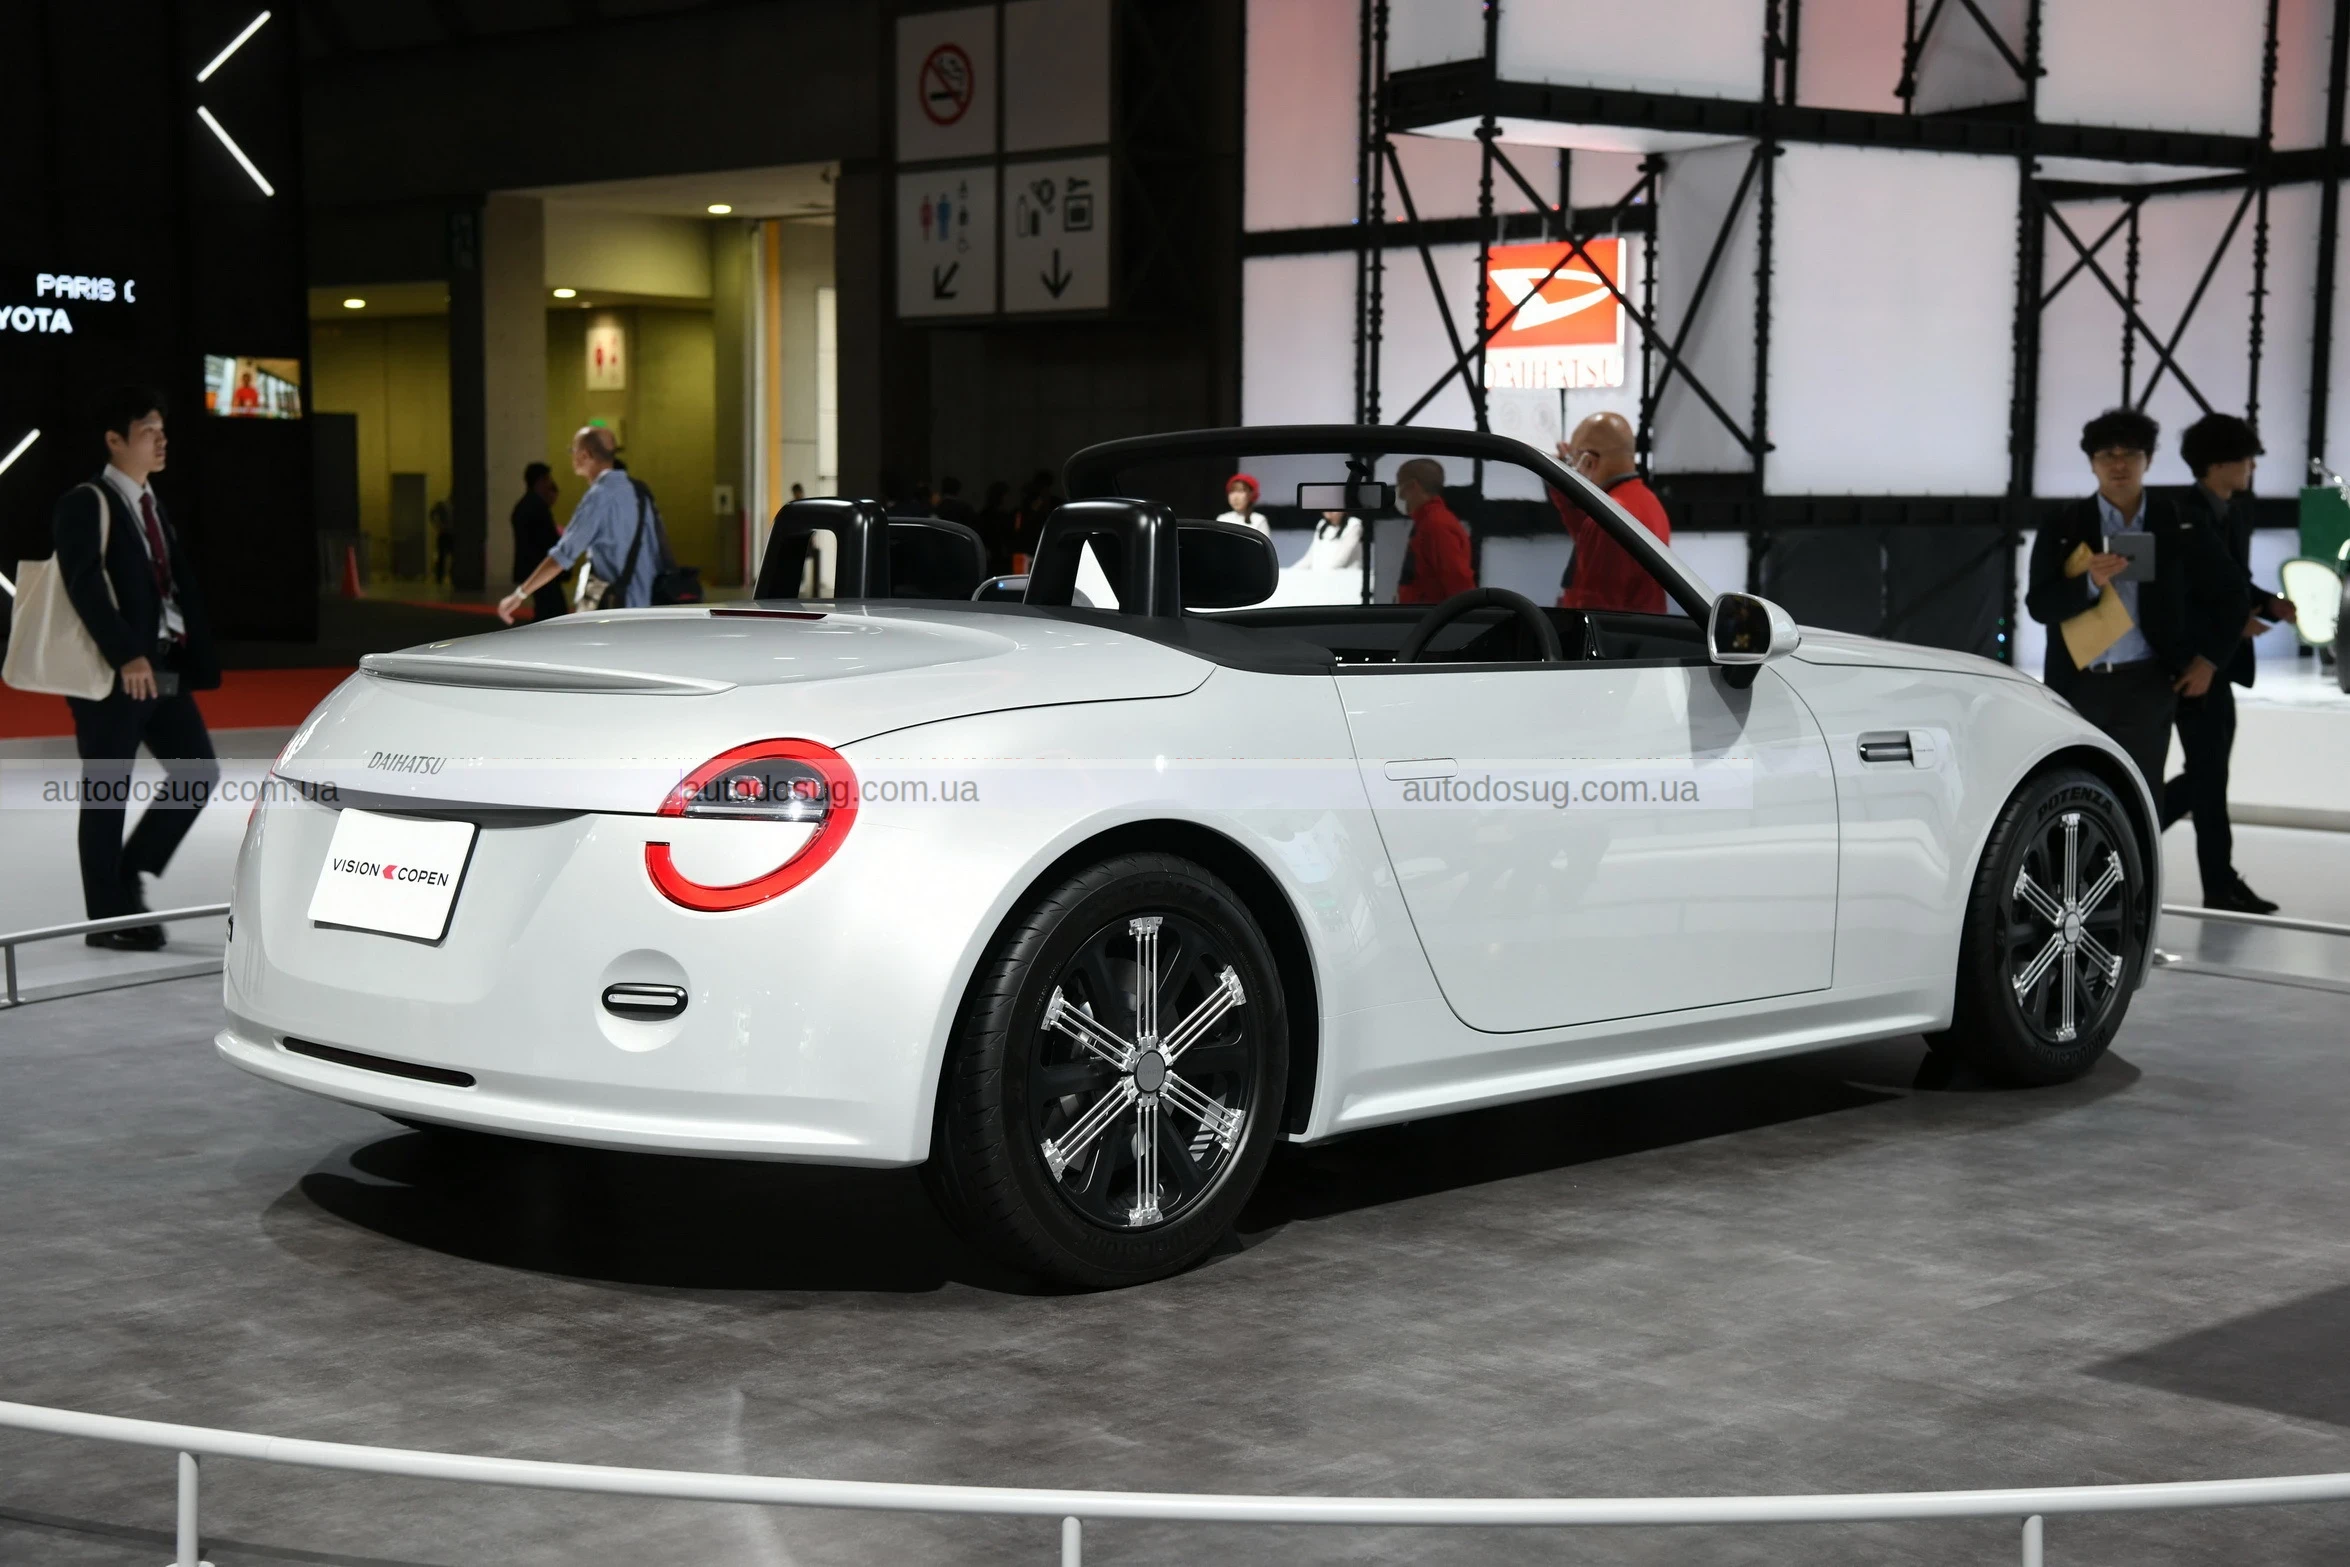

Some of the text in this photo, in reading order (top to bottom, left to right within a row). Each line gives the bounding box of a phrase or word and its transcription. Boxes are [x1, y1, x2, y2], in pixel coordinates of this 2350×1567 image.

[37, 273, 116, 302] PARIS
[367, 751, 447, 775] DAIHATSU
[2037, 786, 2113, 822] POTENZA
[333, 858, 449, 887] VISION COPEN
